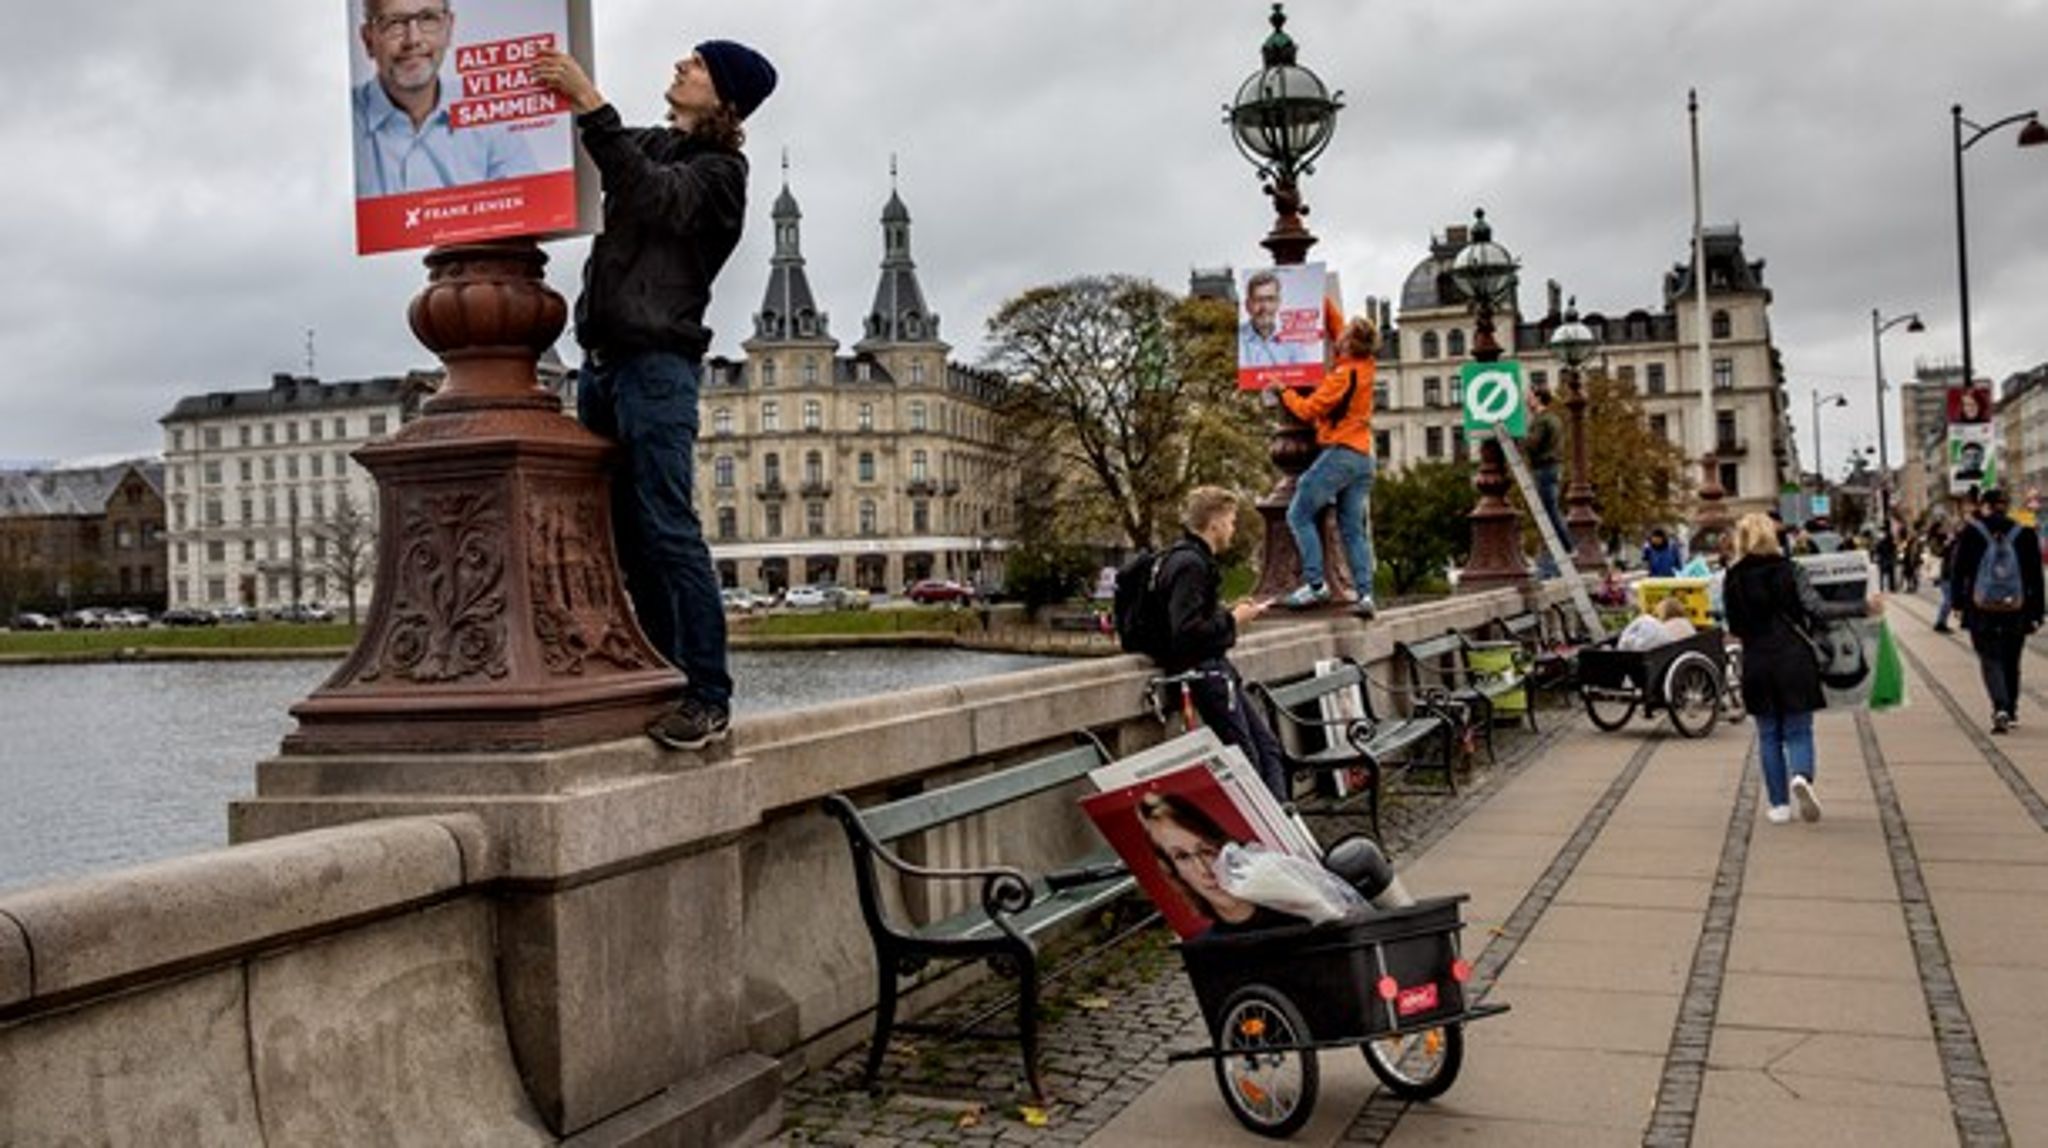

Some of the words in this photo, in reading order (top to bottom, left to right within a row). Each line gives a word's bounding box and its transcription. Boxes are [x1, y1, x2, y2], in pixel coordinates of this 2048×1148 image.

[459, 46, 500, 68] ALT
[506, 38, 552, 61] DET
[467, 75, 491, 95] VI
[459, 93, 555, 126] SAMMEN
[424, 204, 469, 219] FRANK
[473, 197, 524, 215] JENSEN
